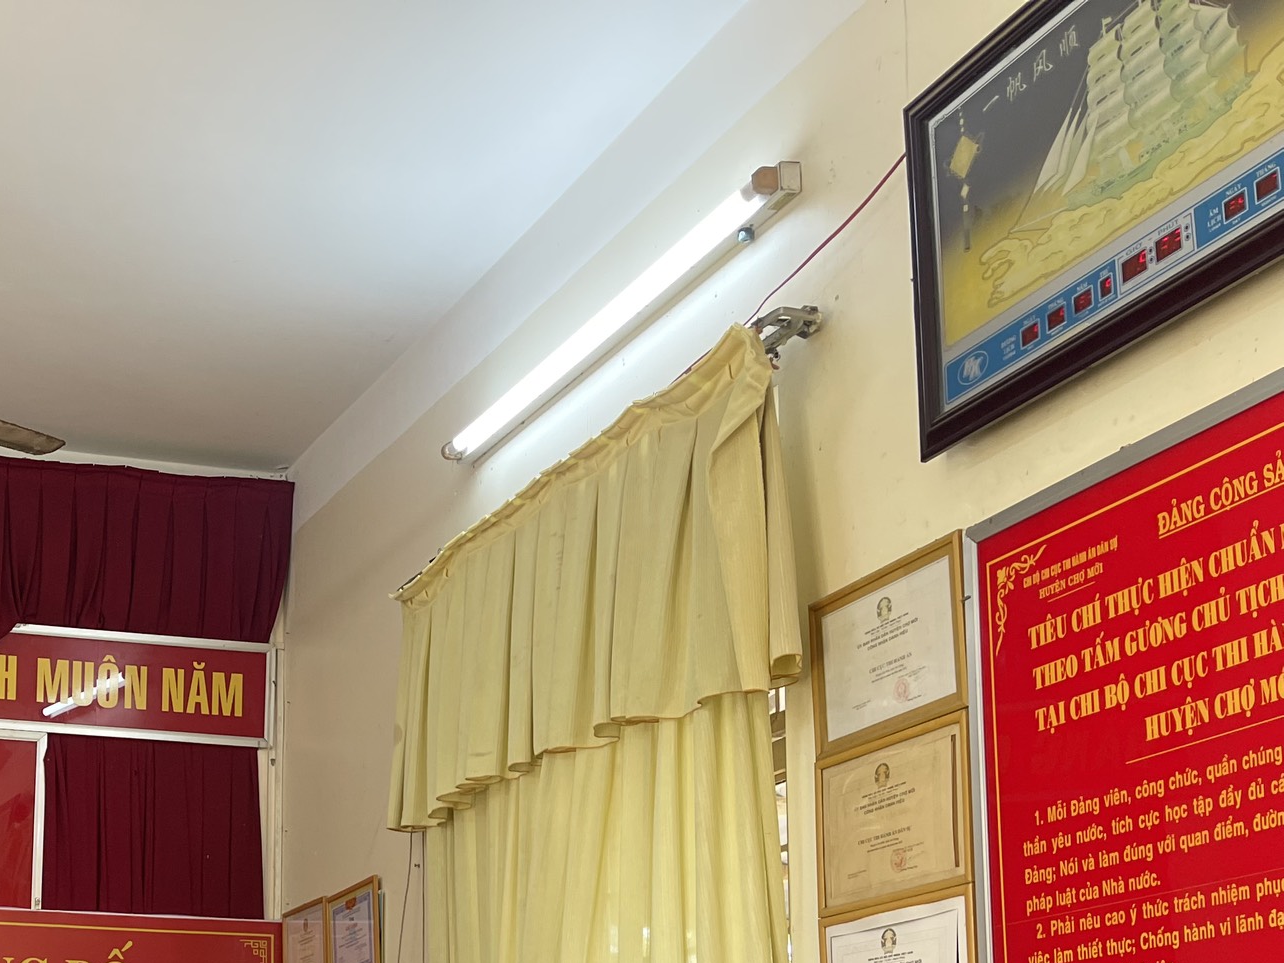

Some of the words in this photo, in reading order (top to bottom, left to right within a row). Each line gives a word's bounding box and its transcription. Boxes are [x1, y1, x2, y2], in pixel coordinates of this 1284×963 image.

[1157, 498, 1204, 536] ĐẢNG
[1027, 613, 1067, 650] TIÊU
[1071, 593, 1102, 633] CHÍ
[1104, 577, 1154, 619] THỰC
[1157, 557, 1204, 599] HIỆN
[1208, 519, 1276, 578] CHUẨN
[1039, 579, 1066, 599] HUYỆN
[1068, 569, 1085, 585] CHỢ
[1087, 562, 1103, 578] MỚI
[1032, 654, 1079, 690] THEO
[1081, 632, 1122, 673] TẤM
[1124, 611, 1187, 657] GƯƠNG
[1191, 586, 1231, 632] CHỦ
[37, 656, 147, 710] MUÔN
[162, 662, 243, 716] NĂM
[1035, 700, 1066, 735] TẠI
[1069, 688, 1101, 721] CHI
[1103, 673, 1130, 711] BỘ
[1133, 665, 1168, 699] CHI
[1170, 651, 1208, 689] CỤC
[1211, 636, 1250, 672] THI
[1252, 619, 1284, 659] HÀ
[1144, 696, 1209, 742] HUYỆN
[1214, 678, 1256, 717] CHỢ
[1035, 811, 1044, 826] 1.
[1047, 800, 1067, 823] Mỗi
[1070, 797, 1100, 817] Đảng
[1103, 787, 1131, 808] viên,
[1135, 779, 1165, 800] công
[1168, 767, 1202, 790] chức,
[1206, 754, 1238, 784] quần
[1241, 745, 1283, 770] chúng
[1026, 892, 1053, 915] pháp
[1055, 887, 1077, 907] luật
[1079, 881, 1100, 902] của
[1102, 876, 1125, 897] Nhà
[1128, 870, 1161, 892] nước.
